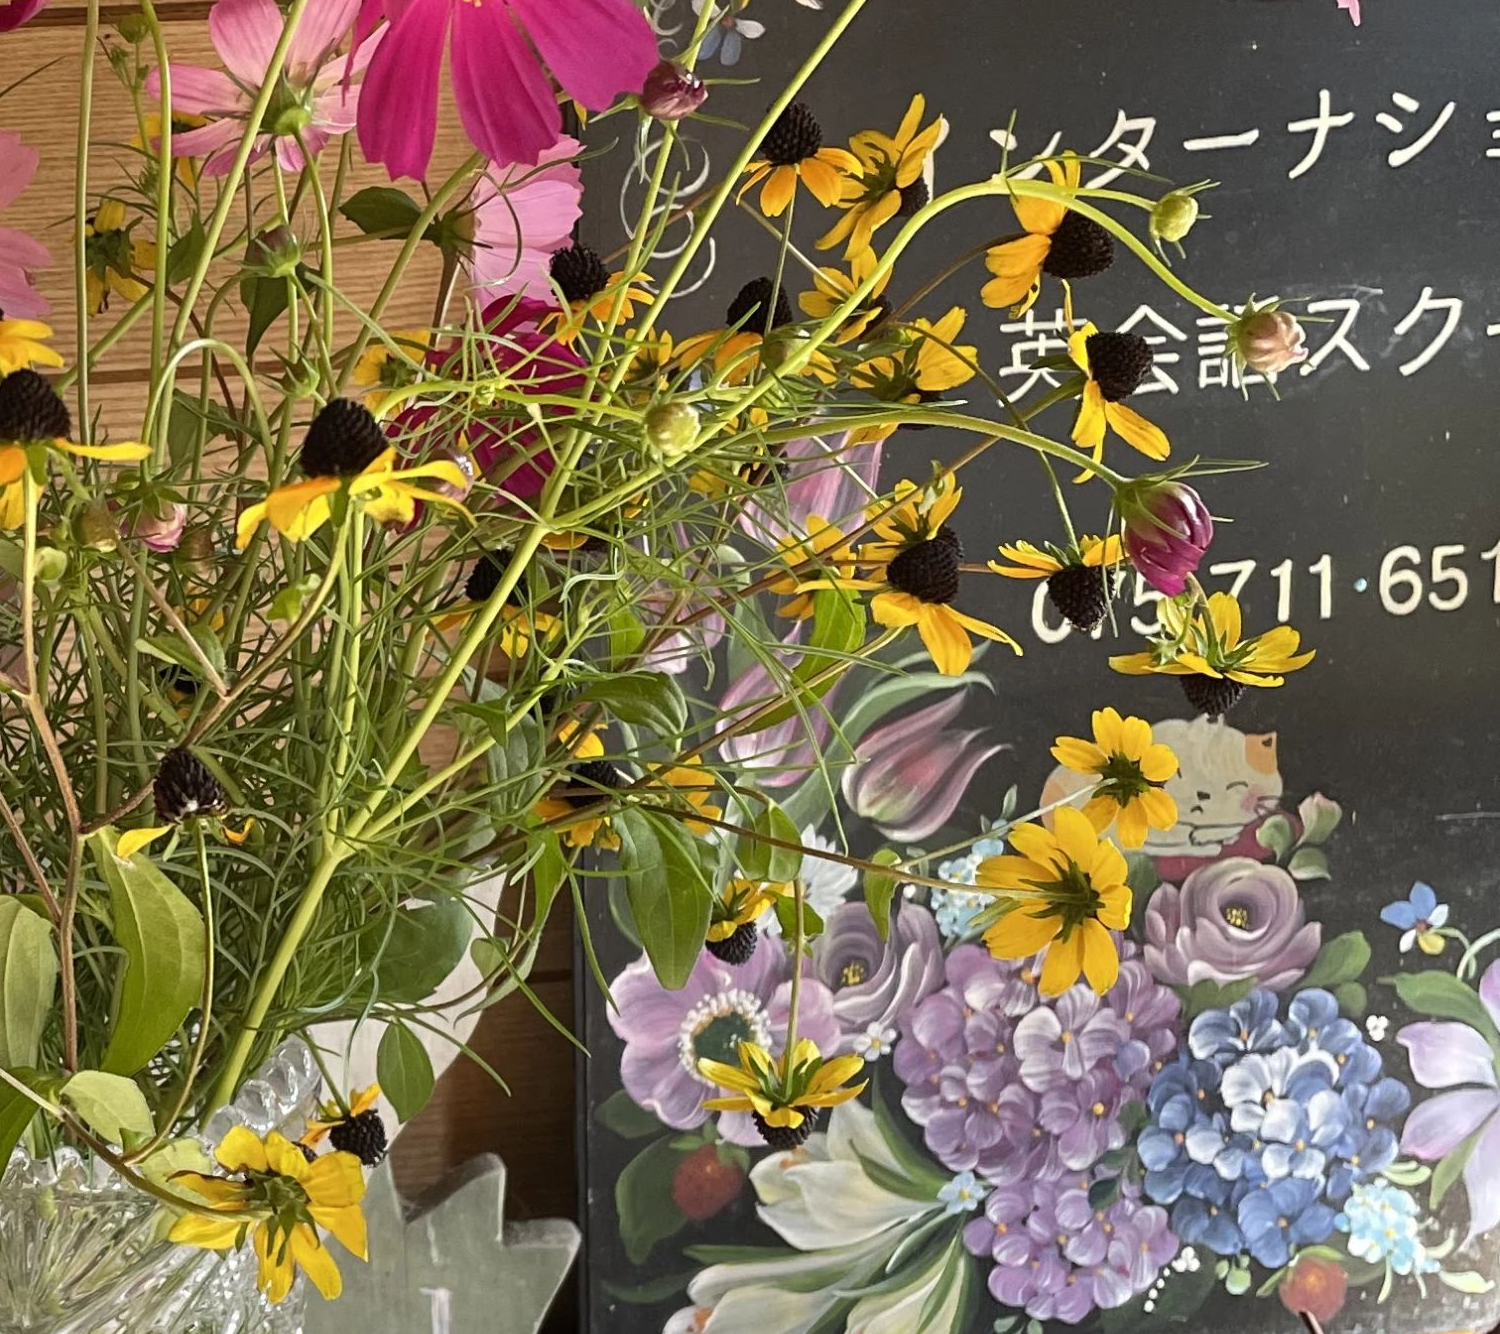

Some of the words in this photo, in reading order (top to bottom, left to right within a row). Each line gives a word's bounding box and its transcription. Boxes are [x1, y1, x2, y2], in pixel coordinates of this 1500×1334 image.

[996, 285, 1500, 408] 英会話スク
